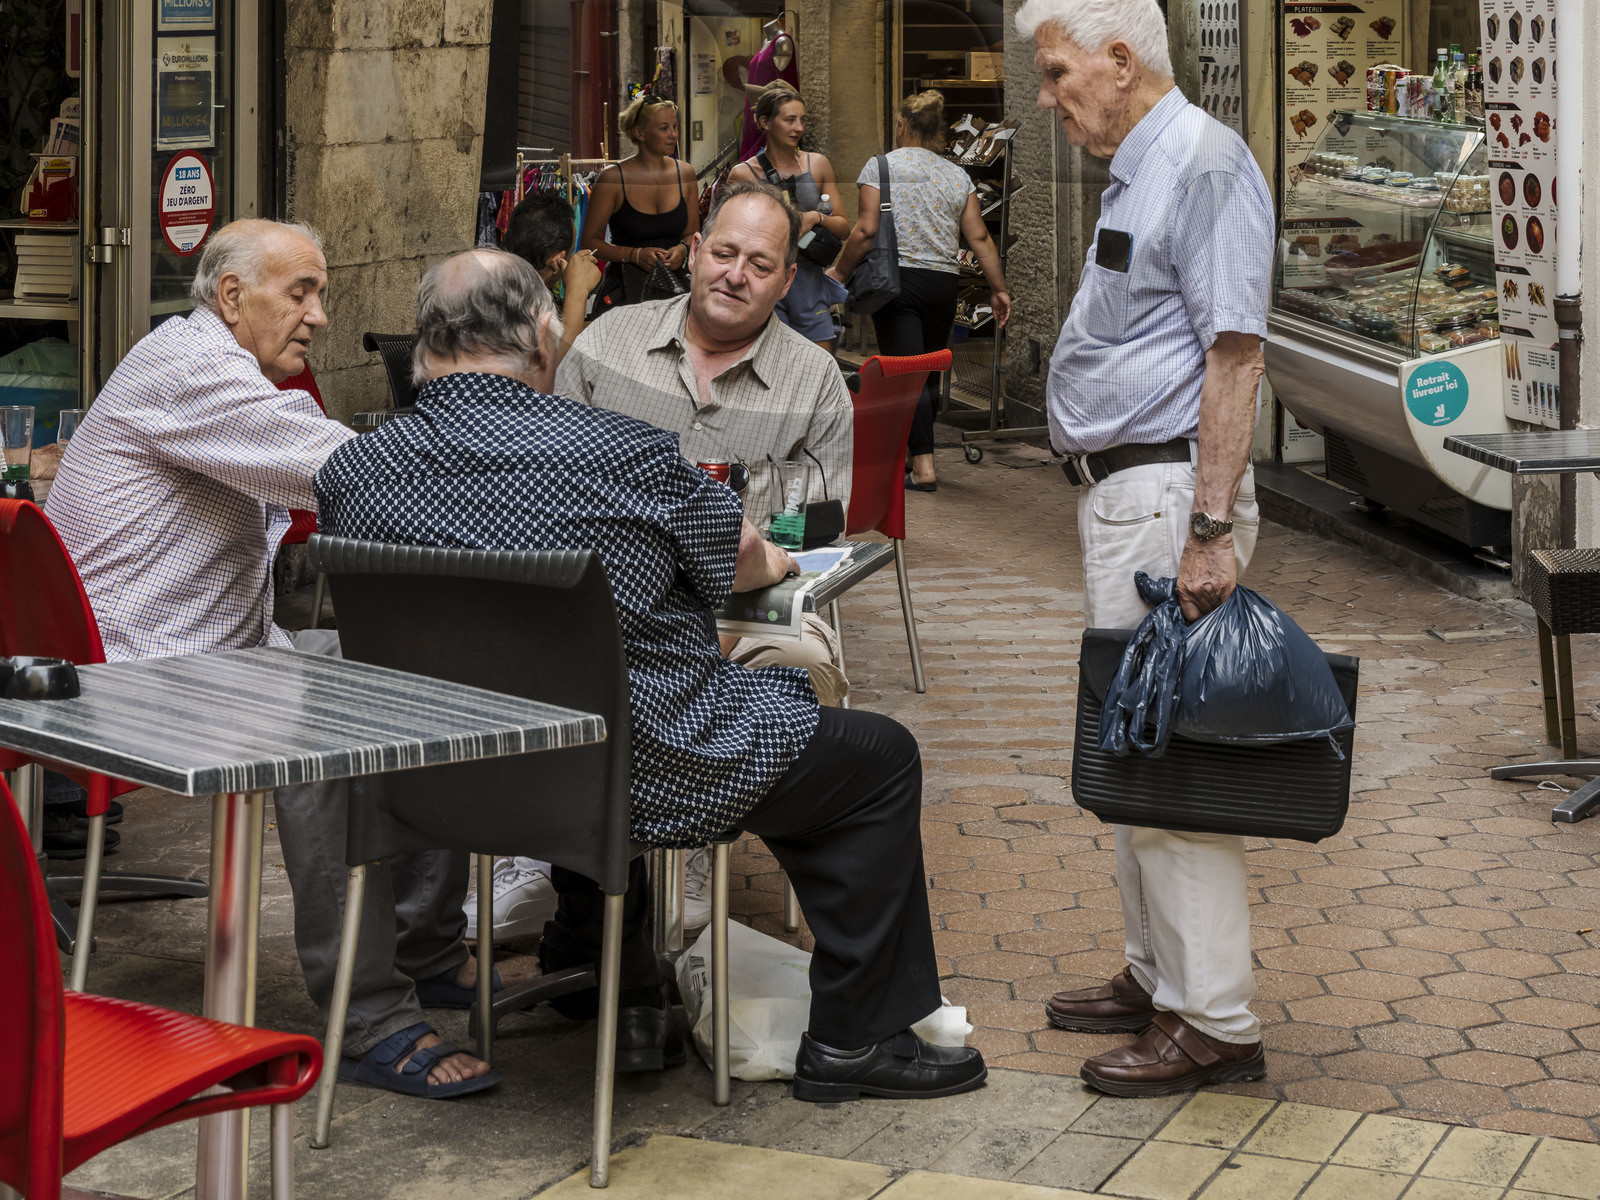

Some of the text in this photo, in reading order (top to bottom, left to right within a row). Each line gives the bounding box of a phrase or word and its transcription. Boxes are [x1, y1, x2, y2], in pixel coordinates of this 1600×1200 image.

[171, 55, 209, 63] EUROMILLIONS
[176, 169, 200, 179] -18 ANS
[180, 184, 196, 195] ZÉRO
[167, 195, 208, 207] JEU D'ARGENT
[1416, 372, 1450, 388] Retrait
[1412, 379, 1458, 399] livreur ici
